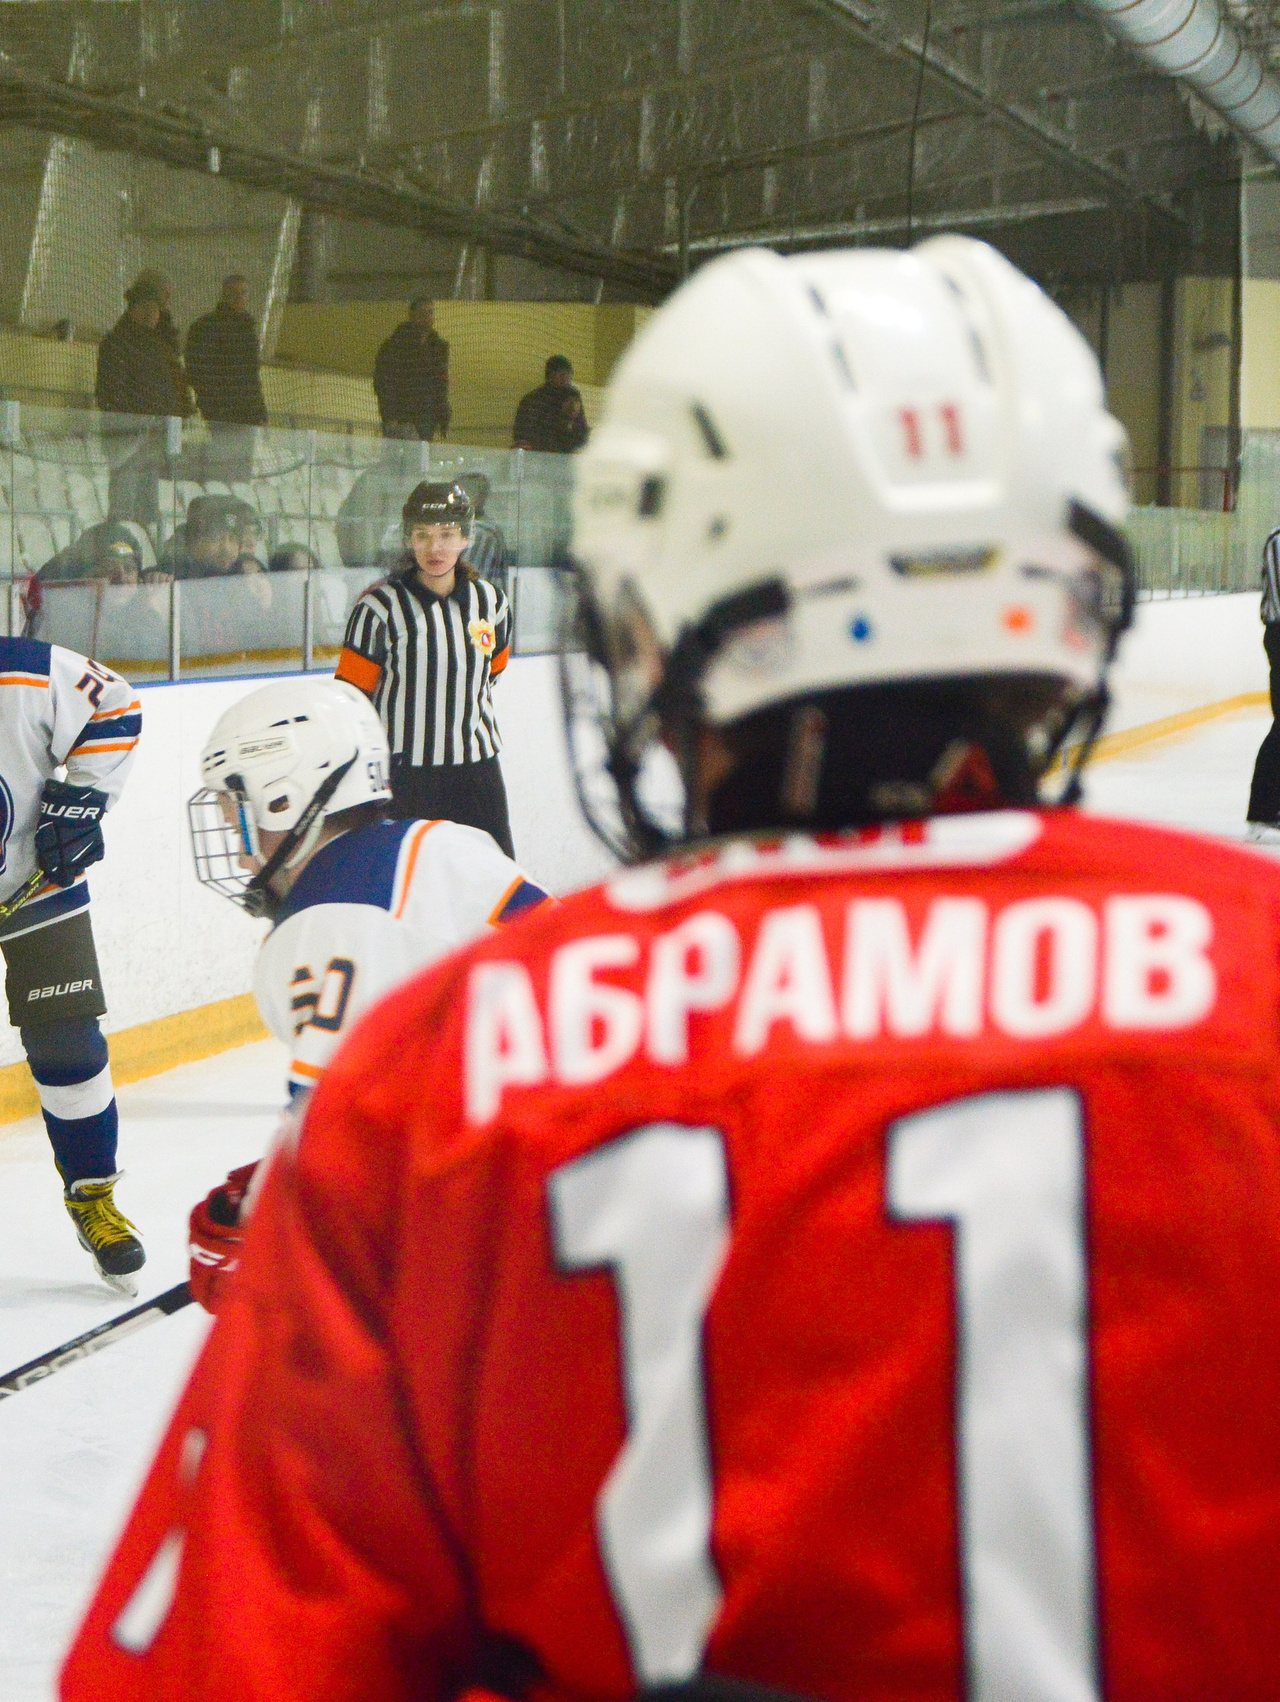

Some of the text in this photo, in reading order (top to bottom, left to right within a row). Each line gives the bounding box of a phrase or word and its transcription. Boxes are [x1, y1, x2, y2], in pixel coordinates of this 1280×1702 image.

[895, 403, 966, 461] 11
[27, 979, 94, 1002] BAUER
[463, 893, 1218, 1126] АБРАМОВ
[546, 1085, 1108, 1702] 11
